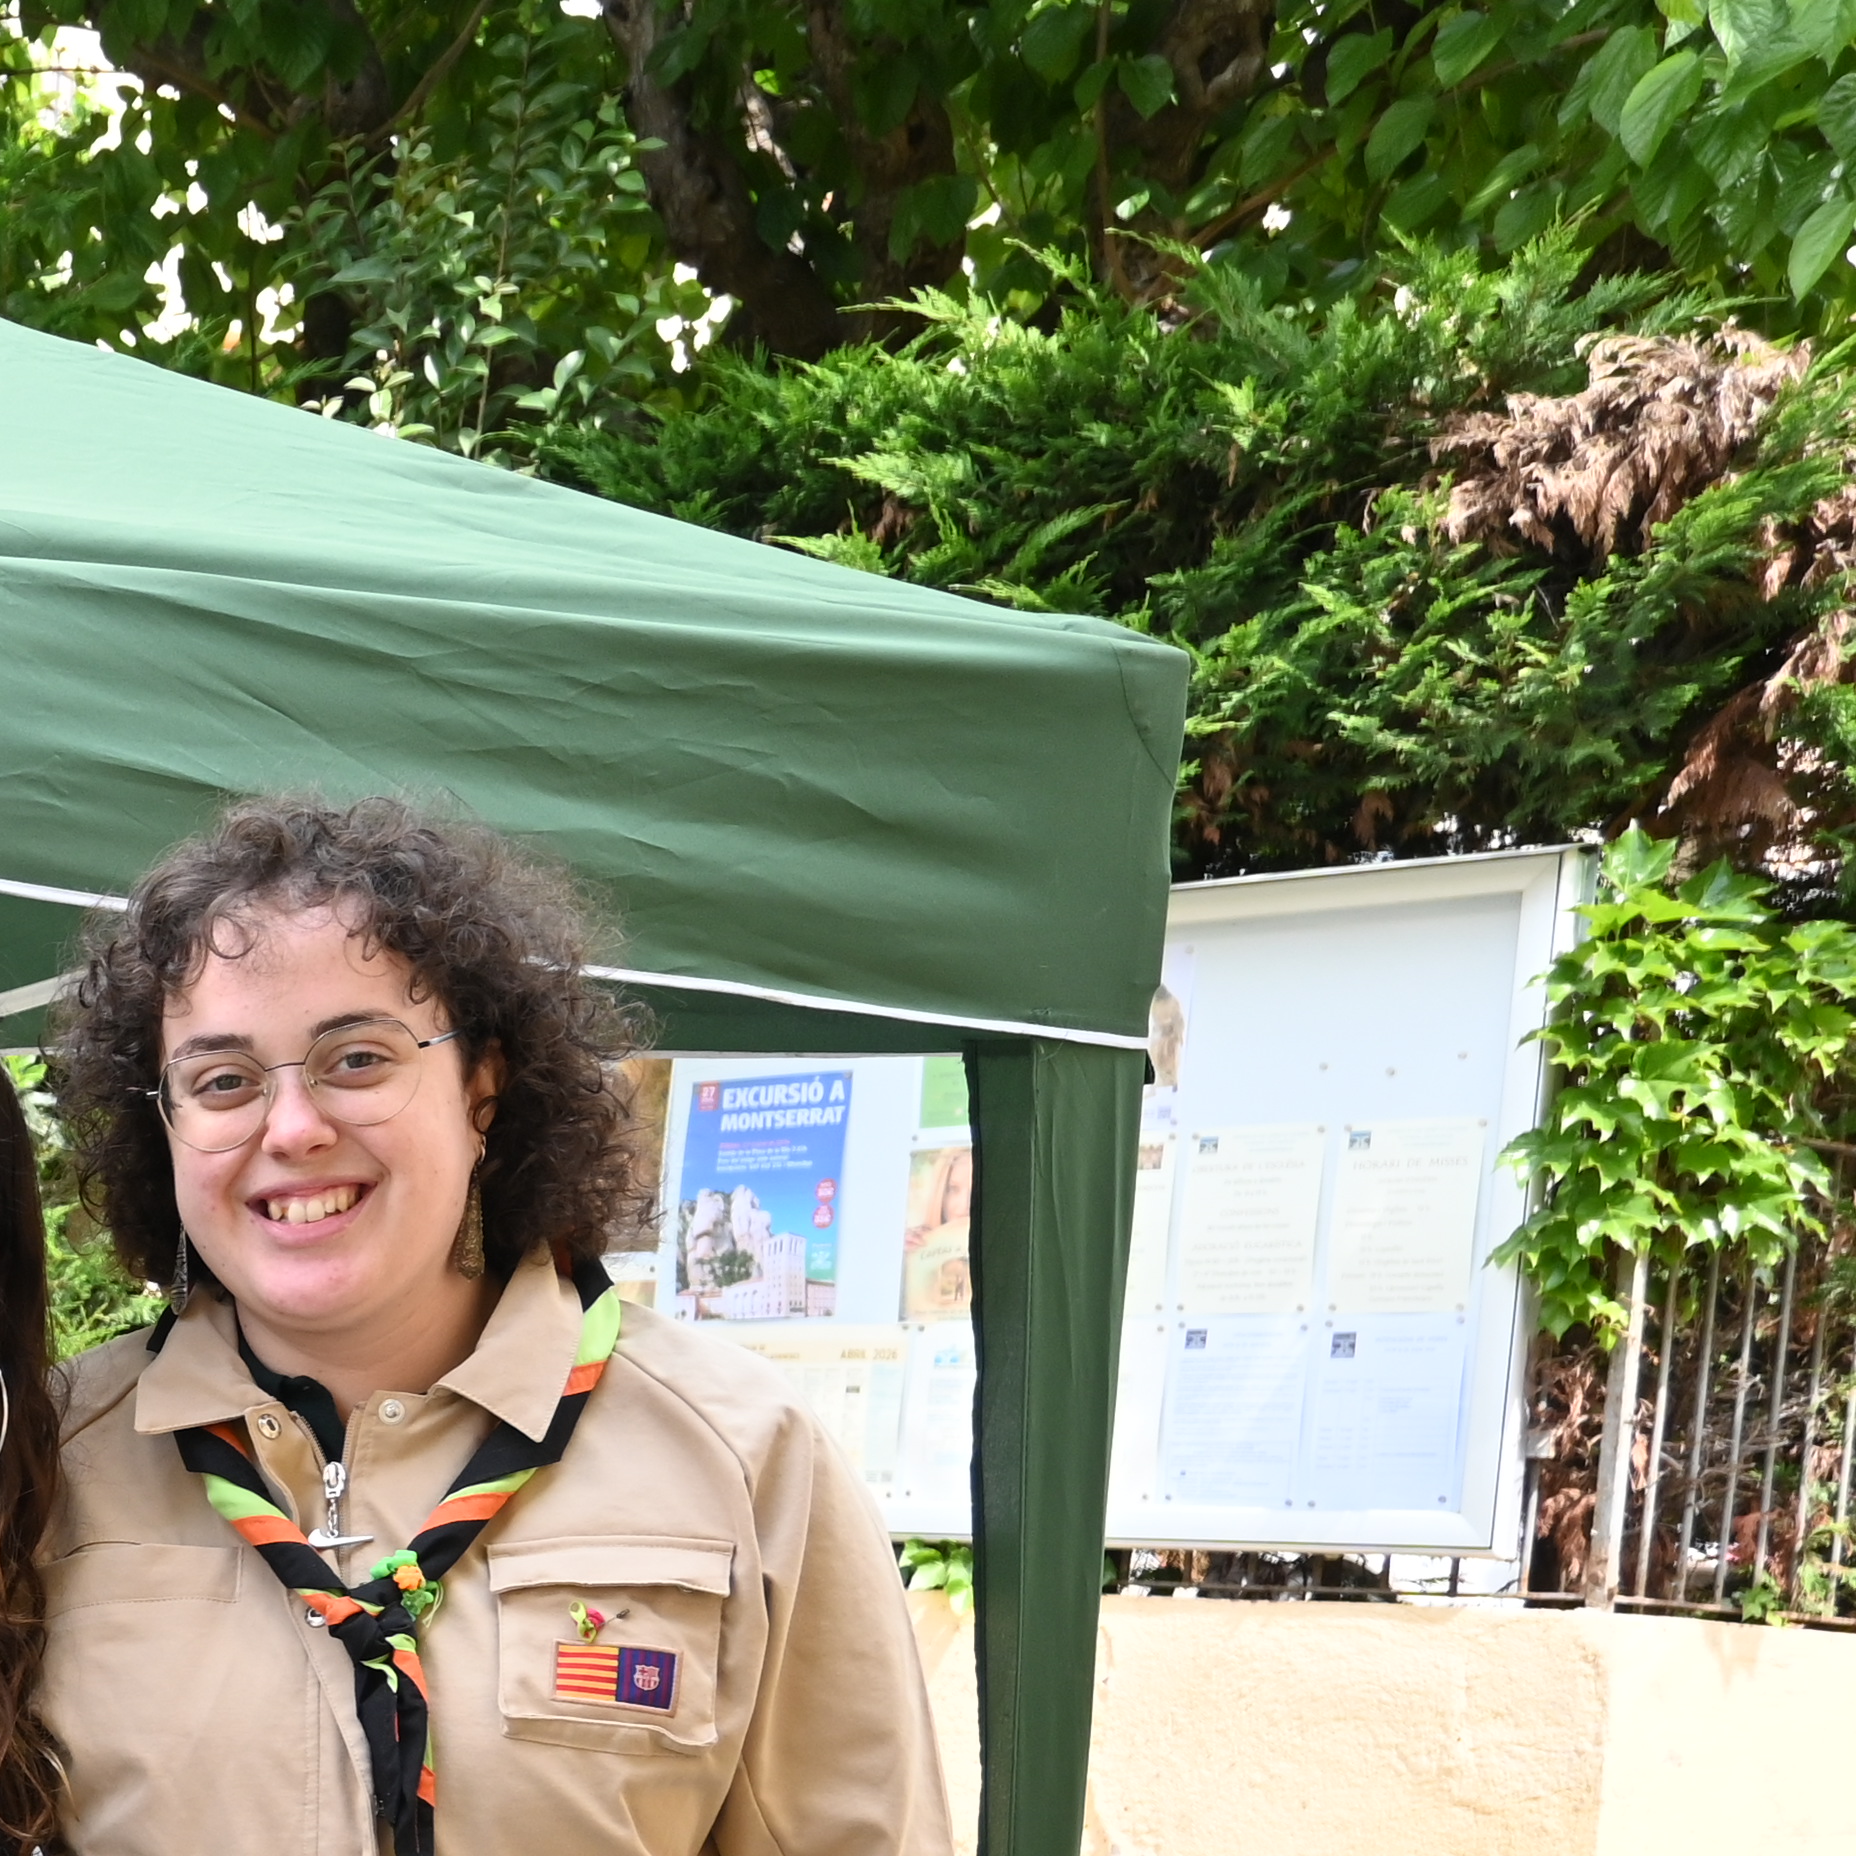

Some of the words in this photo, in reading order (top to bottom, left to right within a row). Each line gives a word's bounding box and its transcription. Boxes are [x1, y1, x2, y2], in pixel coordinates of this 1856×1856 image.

[722, 1076, 825, 1111] EXCURSIÓ
[829, 1079, 846, 1103] A
[720, 1105, 847, 1133] MONTSERRAT
[1406, 1157, 1422, 1169] DE
[1429, 1155, 1469, 1167] MISSES
[840, 1348, 866, 1360] ABRIL
[872, 1347, 898, 1360] 2026
